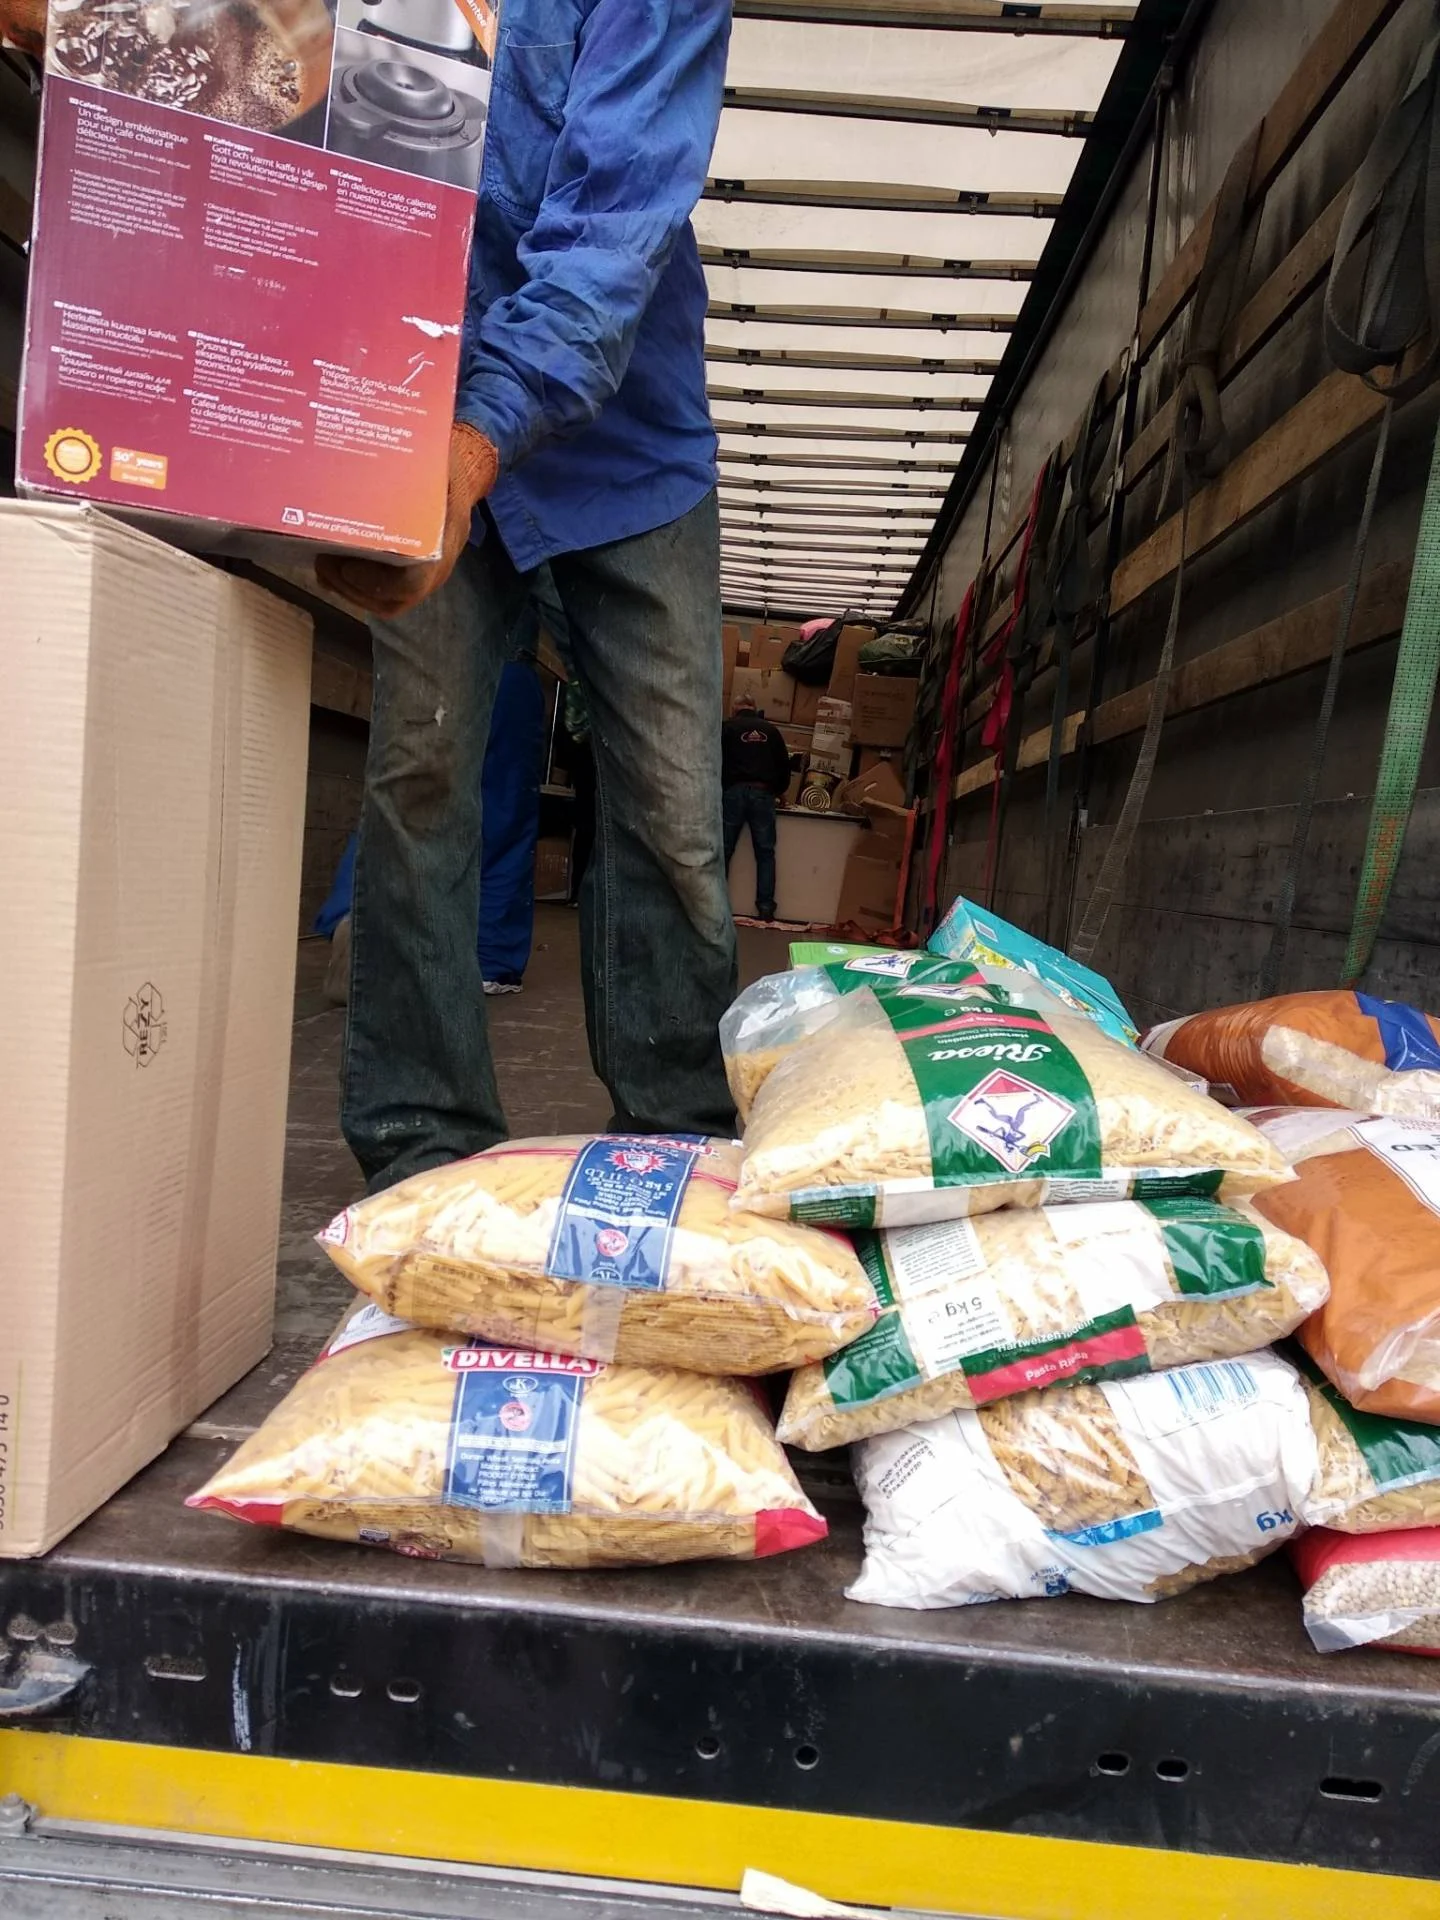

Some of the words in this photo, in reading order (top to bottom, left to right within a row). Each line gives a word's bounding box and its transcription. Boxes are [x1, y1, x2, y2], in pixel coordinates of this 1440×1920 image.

[76, 126, 117, 143] délicieux
[77, 118, 99, 129] pour
[114, 126, 134, 139] café
[135, 133, 164, 146] chaud
[93, 112, 123, 127] design
[124, 121, 189, 145] emblématique
[211, 154, 227, 165] nya
[228, 158, 299, 183] revolutionerande
[300, 176, 328, 191] design
[212, 144, 231, 156] Gott
[232, 150, 249, 160] och
[250, 155, 274, 168] varmt
[275, 161, 296, 174] kaffe
[301, 169, 314, 178] vår
[336, 188, 348, 196] en
[349, 191, 379, 205] nuestro
[380, 199, 409, 212] icónico
[410, 206, 436, 220] diseño
[337, 178, 350, 188] Un
[351, 182, 386, 198] delicioso
[387, 192, 405, 203] café
[406, 197, 437, 211] caliente
[62, 320, 104, 335] klassinen
[105, 330, 145, 344] muotoilu
[111, 320, 147, 335] kuumaa
[195, 349, 233, 364] ekspresu
[260, 353, 283, 365] kawa
[191, 407, 202, 415] cu
[203, 410, 239, 424] designul
[239, 418, 266, 429] nostru
[267, 422, 290, 434] clasic
[306, 518, 422, 548] www.philips.com/welcome
[927, 1042, 1053, 1063] Riesa
[945, 1301, 969, 1317] kg
[971, 1296, 982, 1311] 5
[456, 1350, 593, 1372] DIVELLA
[1024, 1364, 1057, 1381] Pasta
[1256, 1509, 1294, 1534] kg
